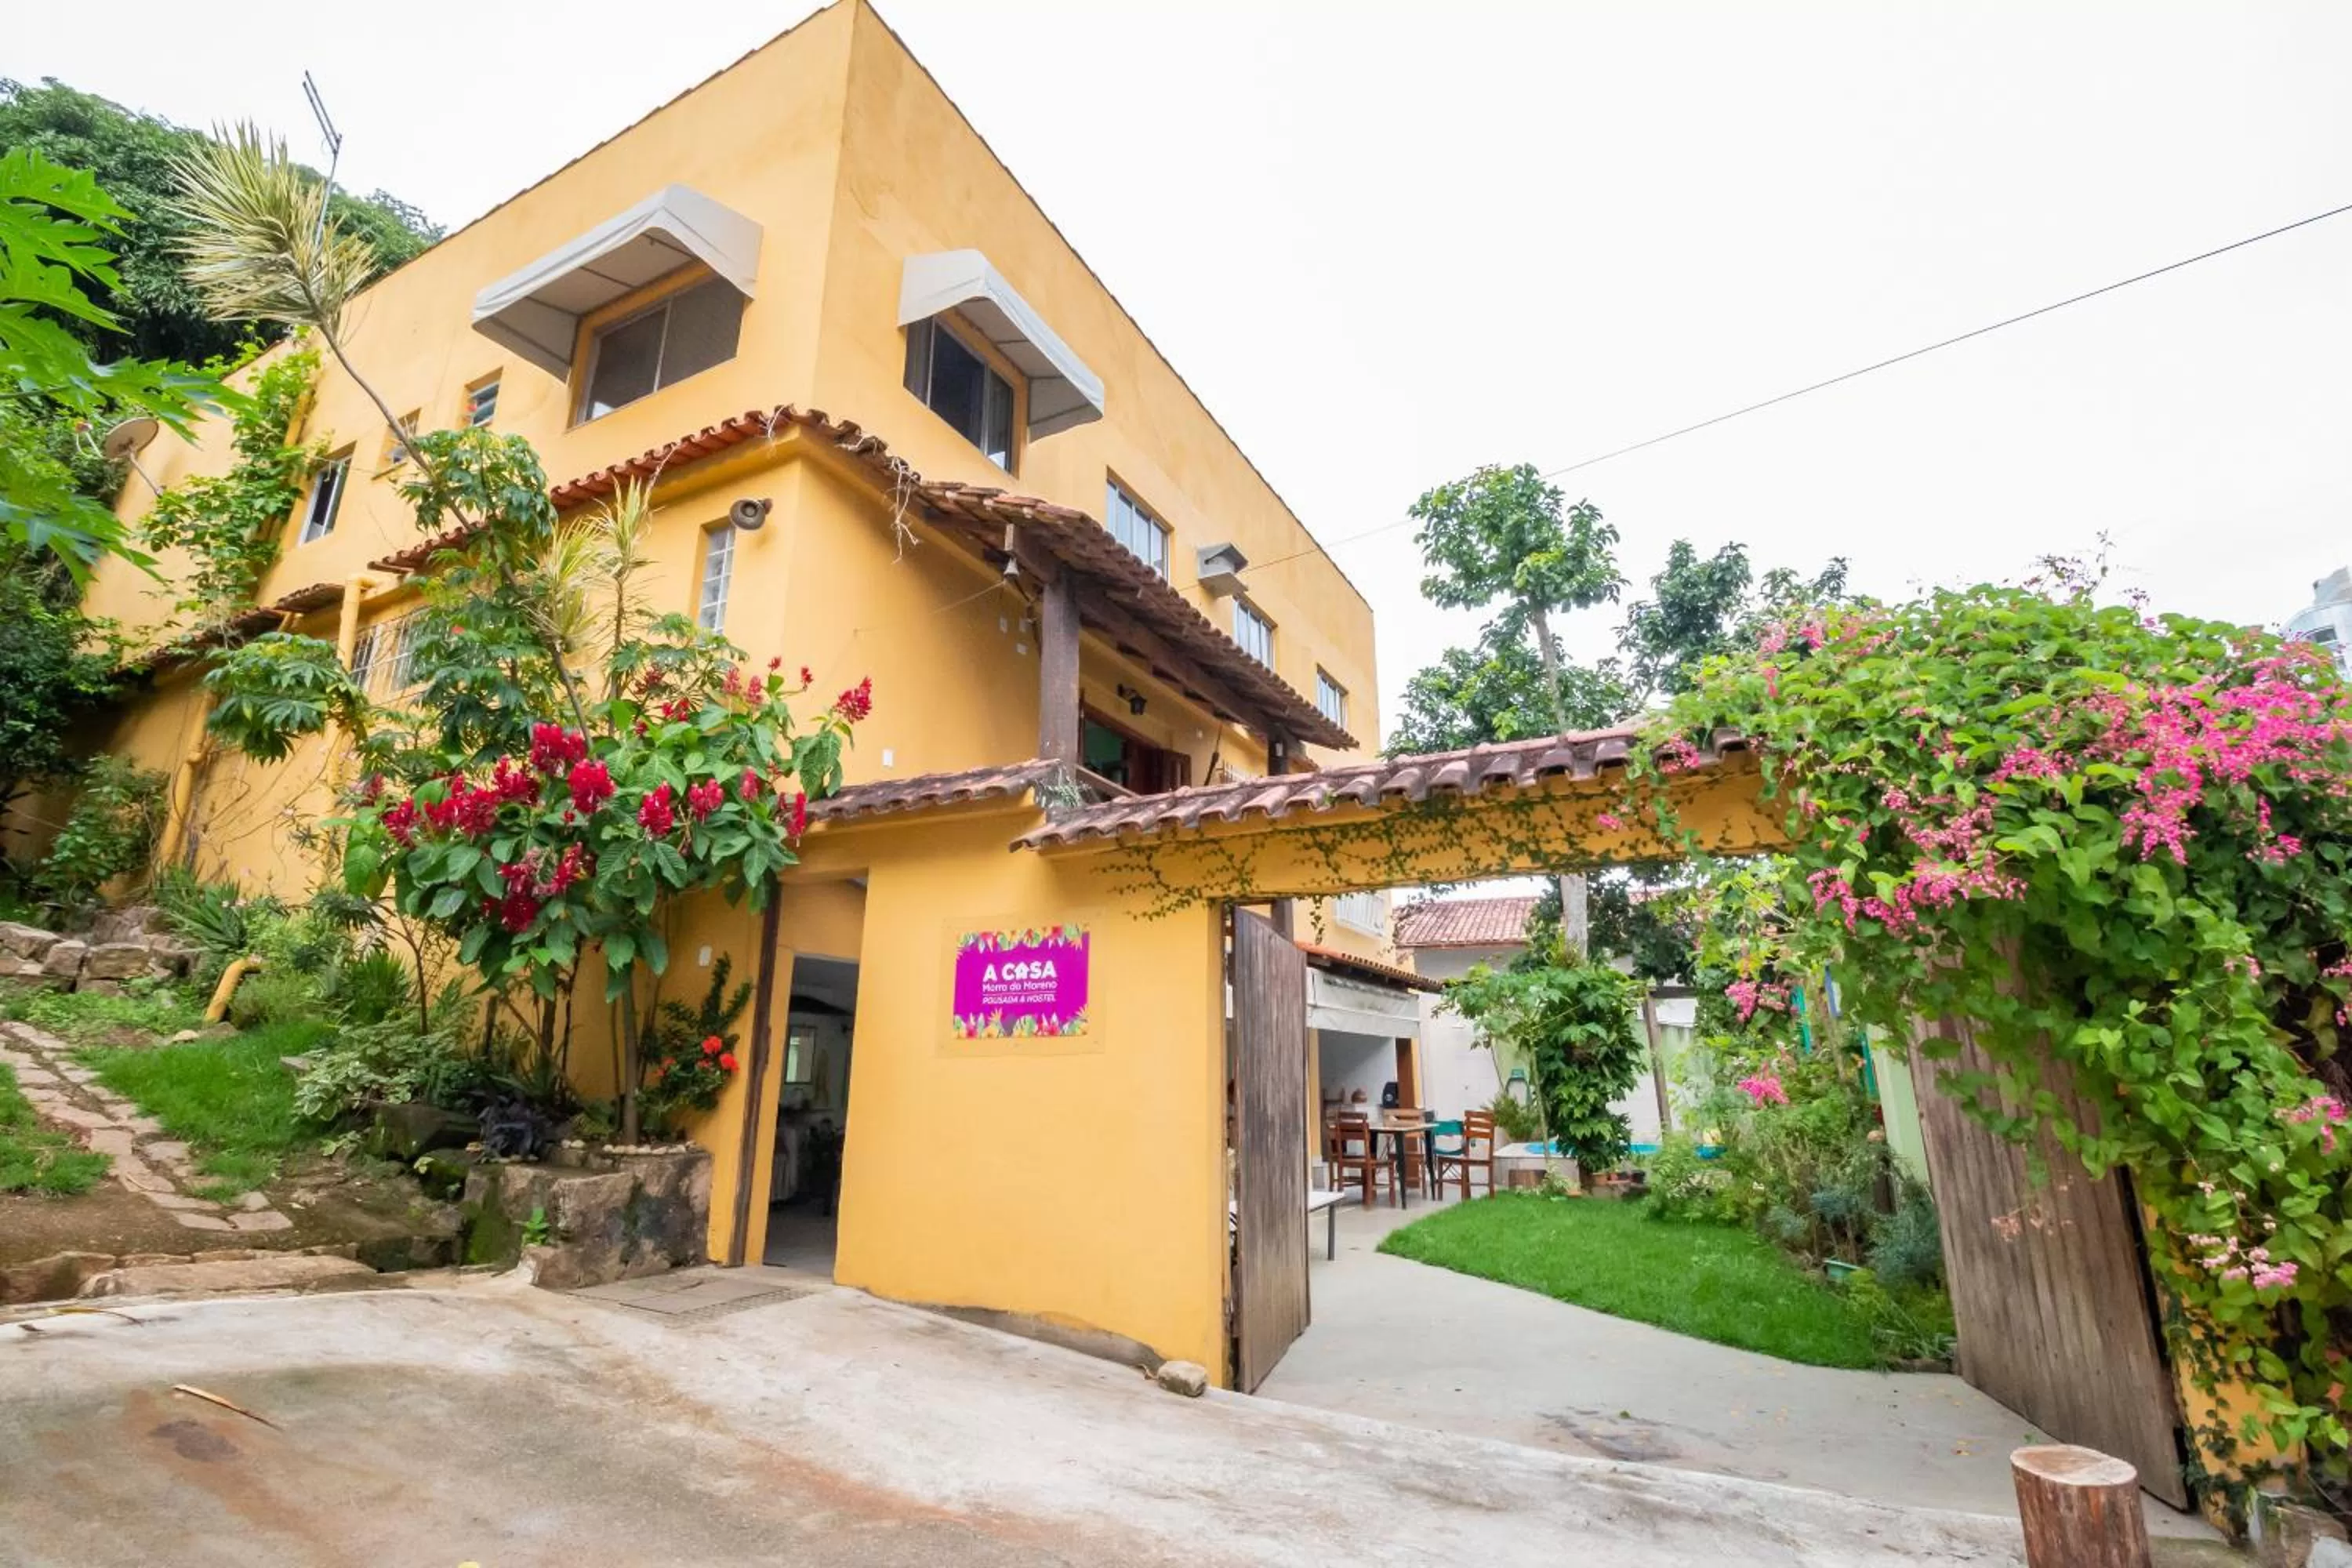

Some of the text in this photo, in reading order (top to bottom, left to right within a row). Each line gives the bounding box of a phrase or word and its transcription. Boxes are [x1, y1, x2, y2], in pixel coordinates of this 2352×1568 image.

[982, 960, 1057, 982] A CASA
[982, 981, 1058, 992] Morro do Moreno
